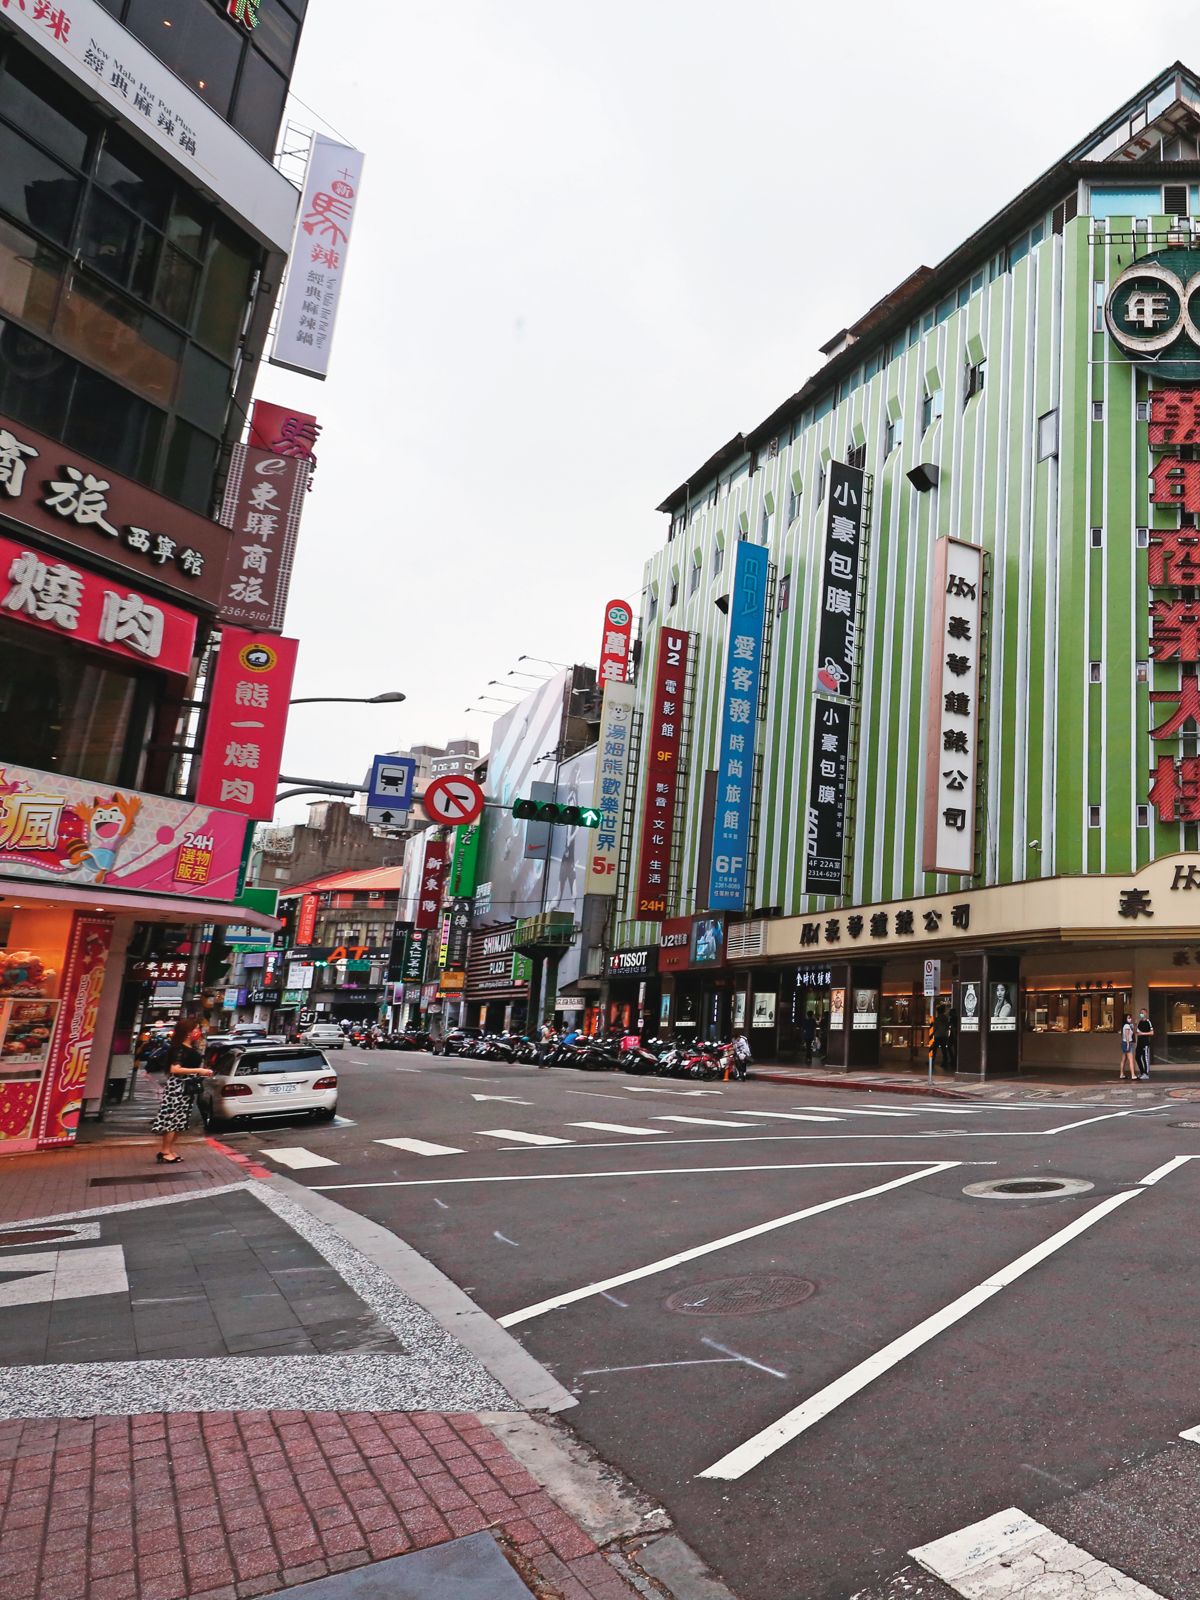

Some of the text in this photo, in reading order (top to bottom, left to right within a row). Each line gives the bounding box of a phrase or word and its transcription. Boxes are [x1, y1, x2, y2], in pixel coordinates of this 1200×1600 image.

[90, 38, 110, 61] New
[113, 58, 137, 84] Mala
[139, 82, 156, 101] Hot
[158, 99, 173, 116] Pot
[83, 49, 197, 157] 經典麻辣鍋
[128, 526, 205, 577] 西寧館
[228, 482, 281, 606] 東驛商旅
[825, 481, 858, 617] 小豪包膜
[4, 551, 165, 659] 燒肉
[220, 605, 272, 622] 2361-5161
[602, 631, 628, 681] 萬年
[667, 636, 682, 666] U2
[661, 679, 677, 737] 電影館
[942, 615, 973, 832] 豪華鐘錶公司
[220, 681, 269, 805] 熊一燒肉
[657, 751, 673, 762] 9F
[818, 709, 840, 806] 小豪包膜
[596, 723, 628, 852] 湯姆熊歡樂世界
[180, 848, 213, 866] 選物
[184, 832, 214, 851] 24H
[177, 864, 209, 882] 販売
[592, 856, 616, 875] 5F
[716, 855, 744, 874] 6F
[808, 869, 841, 878] 2314-6297
[422, 857, 443, 912] 新東陽
[1118, 888, 1154, 919] 豪
[639, 900, 665, 912] 24H
[824, 903, 971, 944] 豪華鐘錶公司
[406, 942, 422, 977] 天仁名茶
[489, 961, 505, 975] PLAZA
[620, 951, 648, 967] TISSOT
